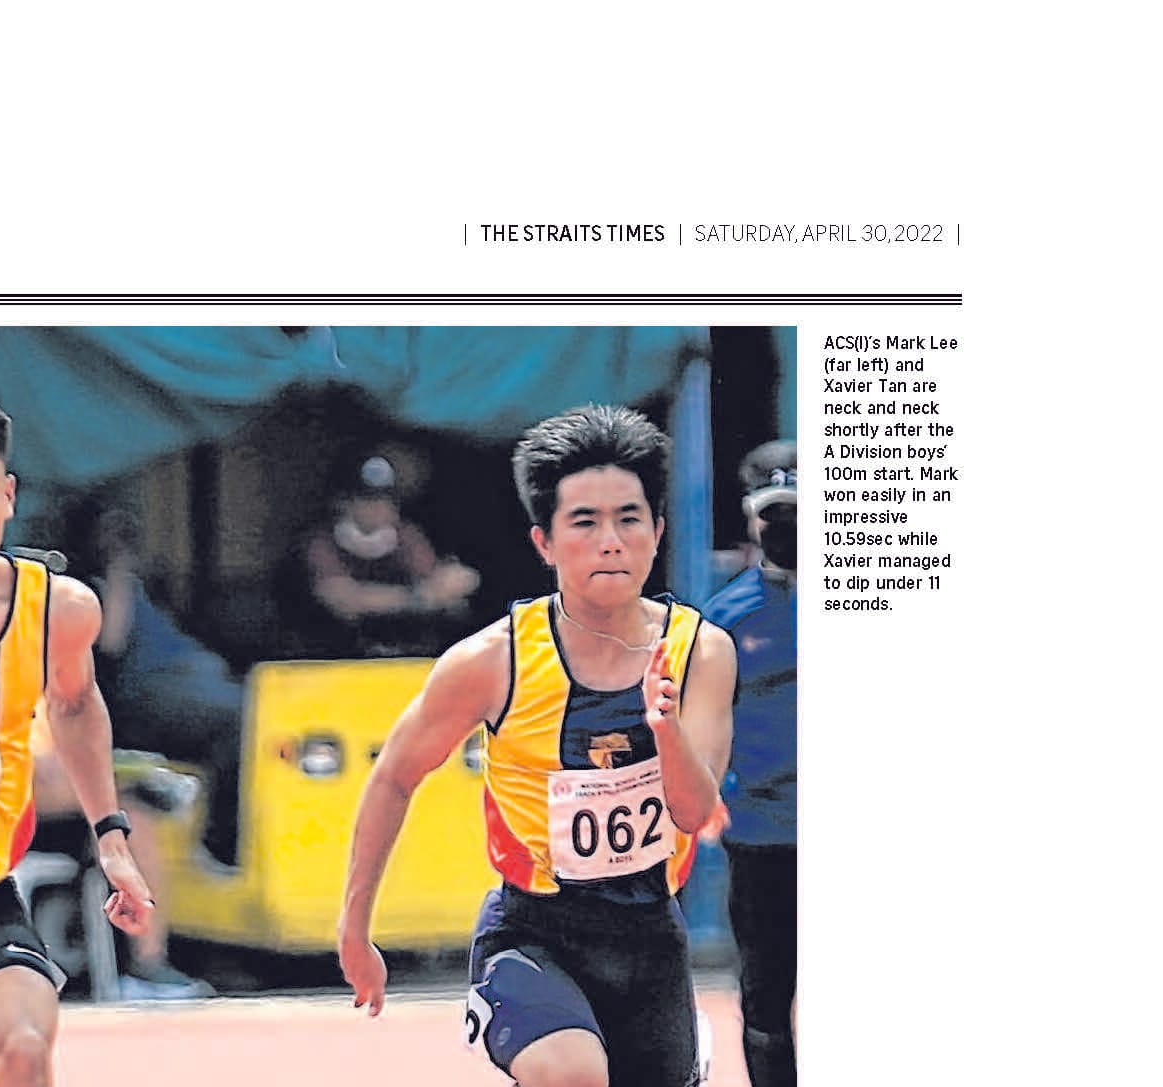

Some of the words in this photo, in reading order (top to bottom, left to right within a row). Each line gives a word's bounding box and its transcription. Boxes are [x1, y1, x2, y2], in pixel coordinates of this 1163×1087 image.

[480, 224, 519, 242] THE
[523, 224, 602, 242] STRAITS
[606, 224, 665, 242] TIMES
[823, 378, 873, 393] Xavier
[878, 378, 907, 393] Tan
[912, 381, 937, 393] are
[824, 400, 862, 415] neck
[867, 400, 896, 415] and
[902, 400, 940, 415] neck
[824, 466, 867, 481] 100m
[873, 466, 914, 481] start.
[920, 466, 959, 481] Mark
[824, 509, 908, 527] impressive
[824, 531, 893, 546] 10.59sec
[897, 531, 938, 546] while
[824, 596, 893, 611] seconds.
[571, 796, 663, 858] 062
